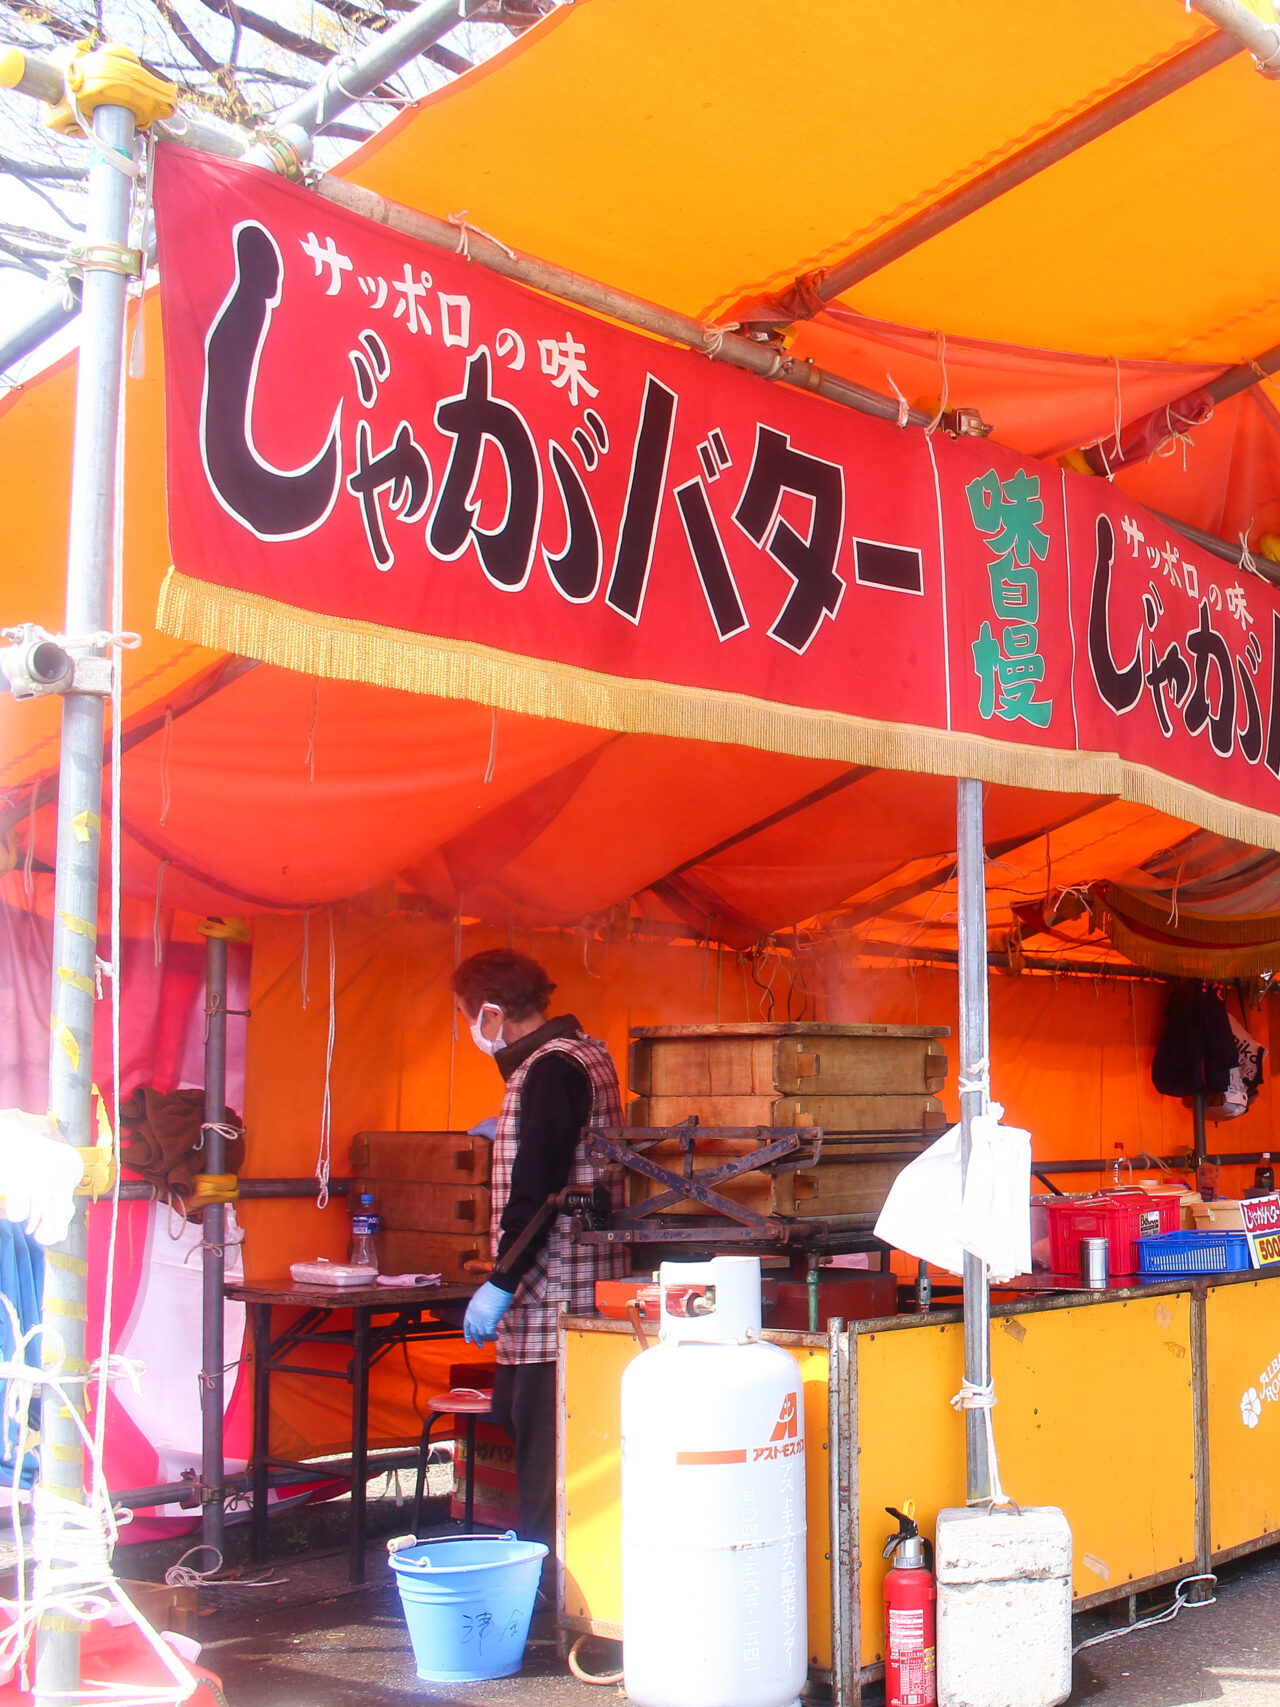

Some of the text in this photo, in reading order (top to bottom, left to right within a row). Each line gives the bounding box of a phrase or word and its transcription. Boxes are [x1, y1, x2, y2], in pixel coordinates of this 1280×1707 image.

[299, 231, 600, 407] サッポロの味
[200, 218, 923, 656] じゃがバター
[965, 467, 1053, 729] 味自慢
[1121, 515, 1254, 631] サッポロの味
